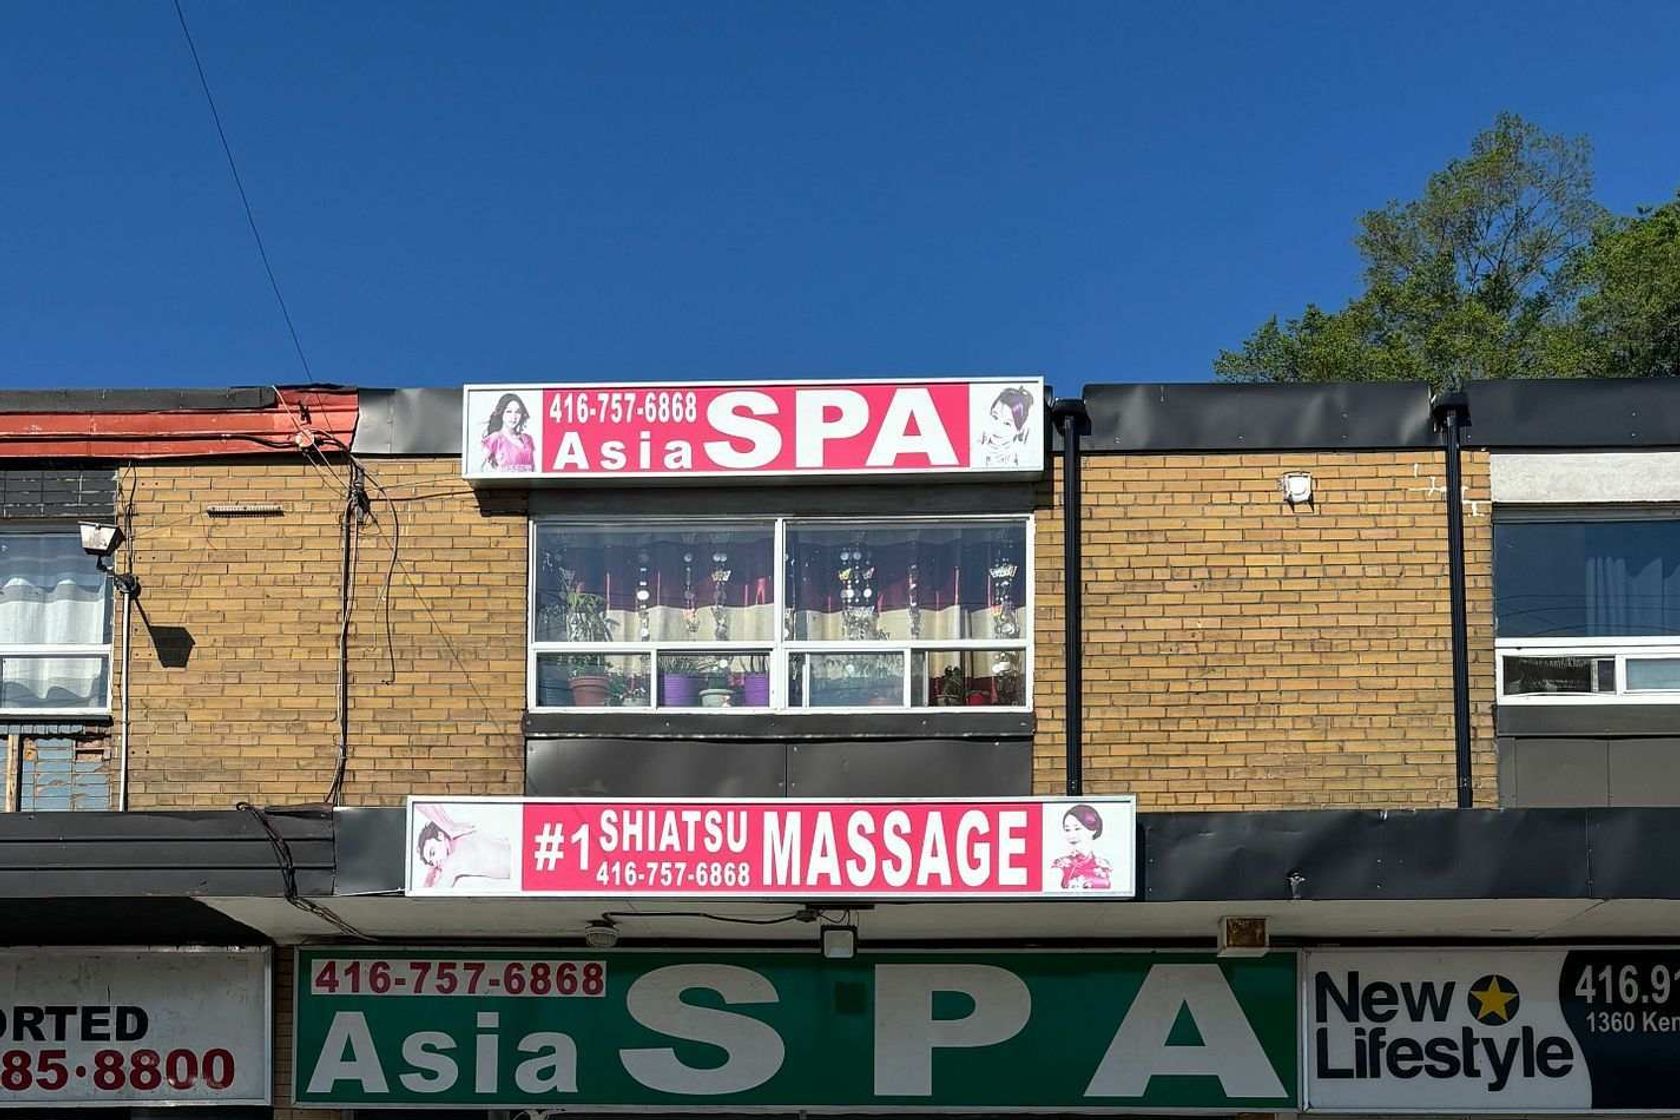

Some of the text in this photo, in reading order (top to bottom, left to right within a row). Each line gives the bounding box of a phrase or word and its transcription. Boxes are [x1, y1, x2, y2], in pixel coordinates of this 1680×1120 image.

[549, 392, 697, 424] 416-757-6868
[552, 387, 963, 471] Asia SPA
[533, 809, 1029, 888] #1 SHIATSU MASSAGE
[596, 860, 751, 887] 416-757-6868
[315, 961, 605, 995] 416-757-6868
[1315, 970, 1456, 1023] New
[0, 1006, 150, 1042] RTED
[306, 963, 1289, 1097] Asia SPA
[1586, 1011, 1635, 1032] 1360
[1316, 1025, 1574, 1092] Lifestyle
